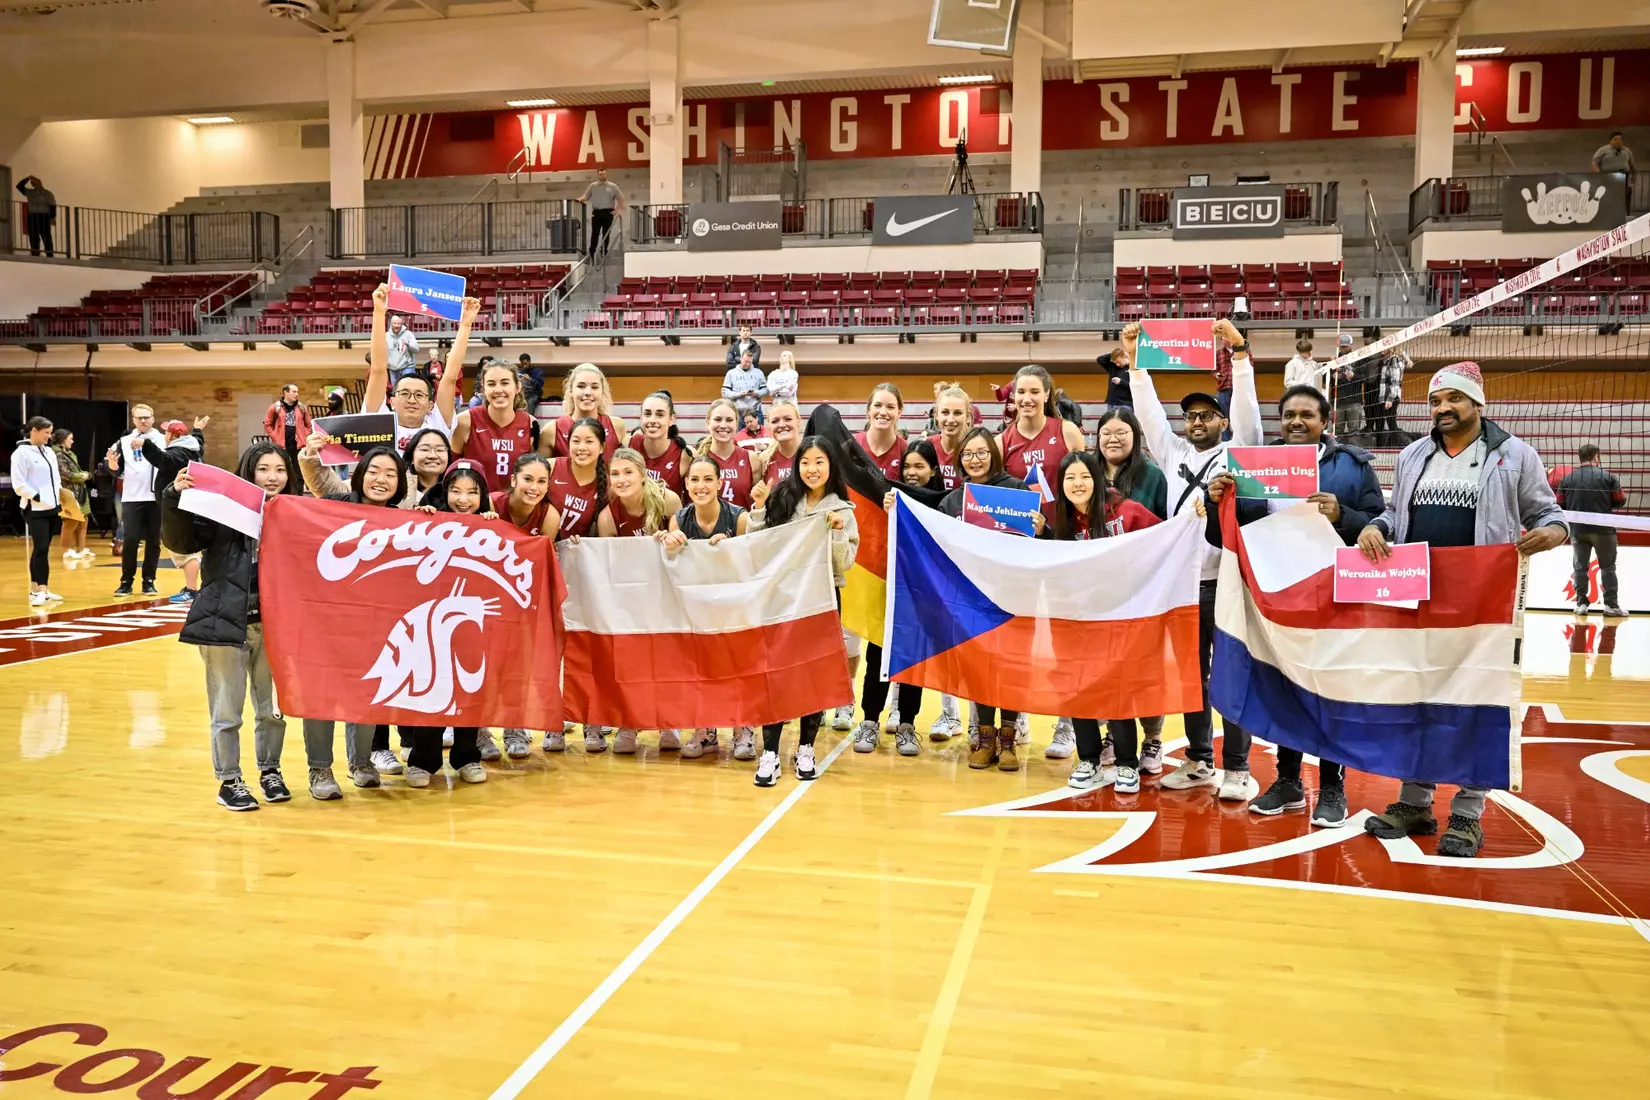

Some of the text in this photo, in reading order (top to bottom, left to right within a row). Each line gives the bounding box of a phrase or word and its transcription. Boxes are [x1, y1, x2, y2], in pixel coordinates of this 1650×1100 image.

[1098, 71, 1361, 141] STATE
[1186, 204, 1272, 221] BECU
[711, 221, 778, 231] Gesa Credit Union
[392, 282, 462, 303] Laura Jansen
[421, 303, 428, 312] 5
[1139, 338, 1212, 350] Argentina Ung
[1168, 356, 1182, 365] 12
[344, 433, 393, 444] Timmer
[492, 439, 513, 451] WSU
[352, 450, 360, 458] 7
[1023, 449, 1045, 464] WSU
[496, 453, 509, 475] 8
[1231, 466, 1315, 478] Argentina Ung
[722, 480, 734, 501] 4
[1264, 486, 1280, 495] 12
[564, 493, 588, 513] WSU
[966, 502, 993, 514] Magda
[559, 508, 582, 532] 17
[994, 521, 1007, 530] 15
[316, 518, 534, 597] Cougars
[1338, 569, 1387, 578] Weronika
[1376, 587, 1390, 597] 16
[0, 1022, 383, 1100] Court
